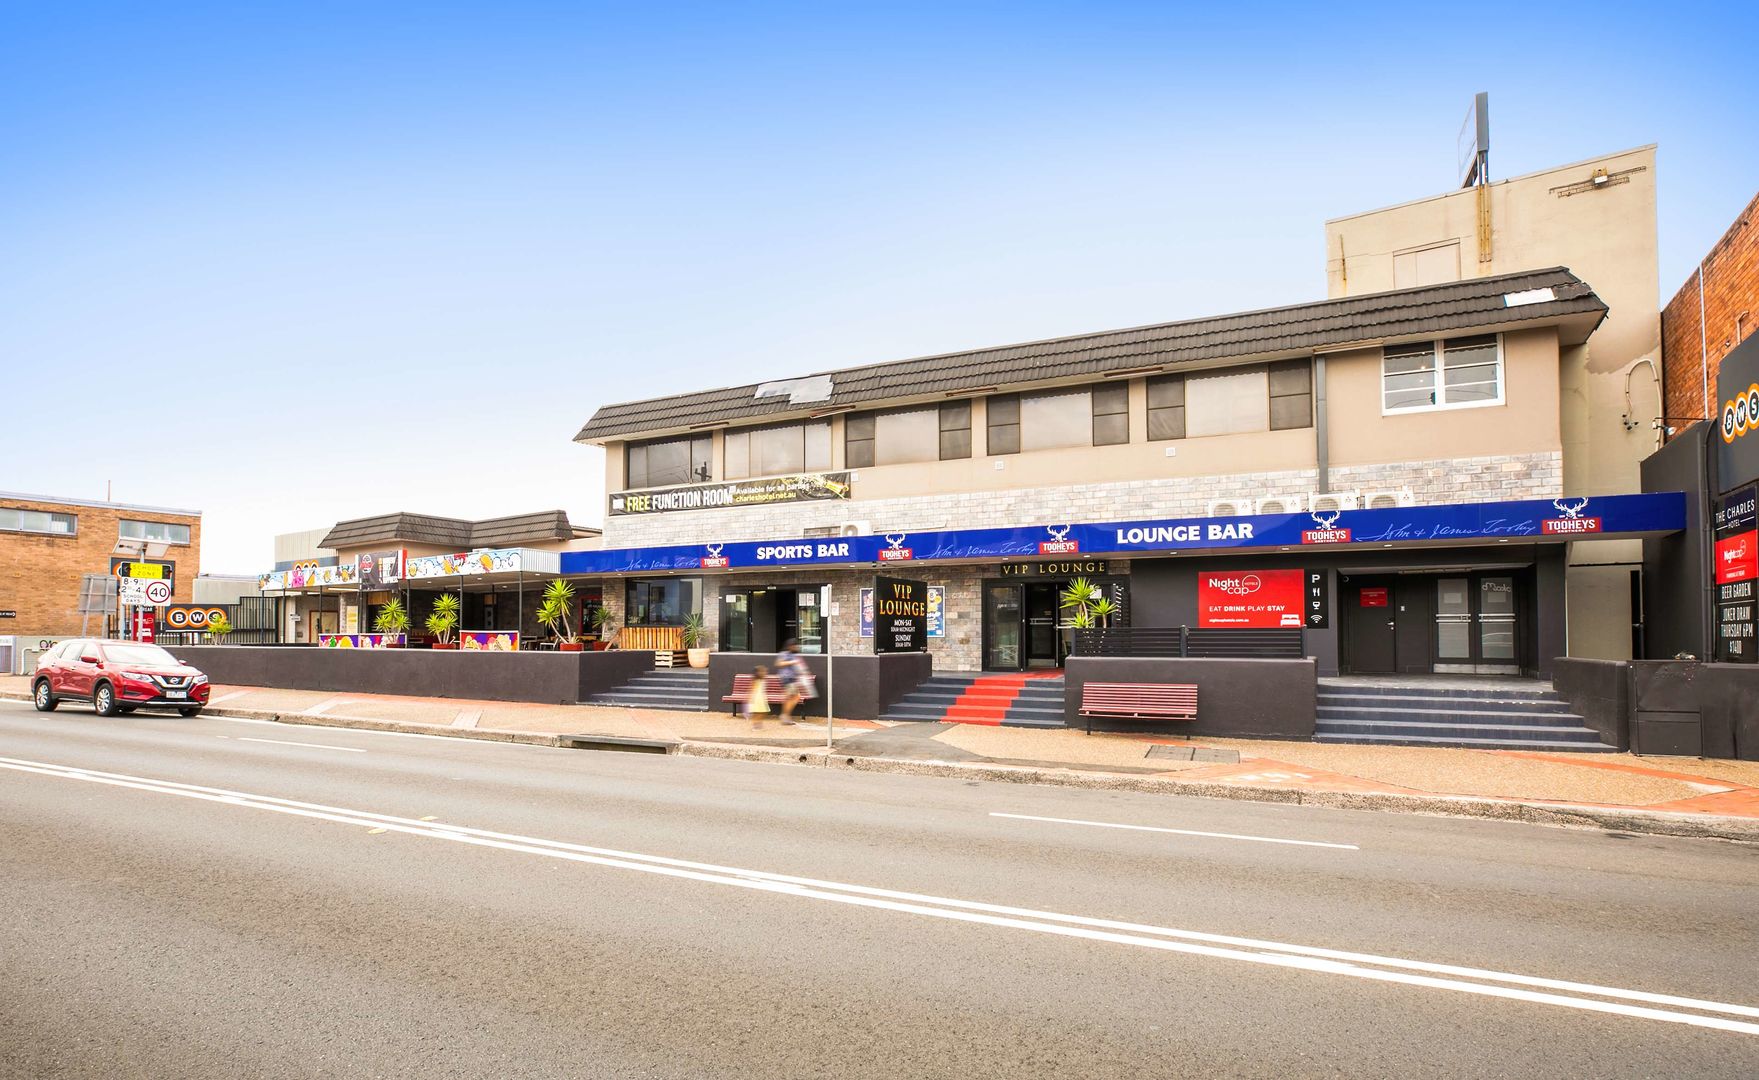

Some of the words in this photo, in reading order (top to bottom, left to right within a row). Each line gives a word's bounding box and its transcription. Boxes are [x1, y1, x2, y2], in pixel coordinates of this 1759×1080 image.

[1726, 398, 1757, 430] BWS
[736, 485, 765, 494] Available
[626, 496, 650, 511] FREE
[652, 490, 700, 510] FUNCTION
[703, 488, 733, 506] ROOM
[1715, 510, 1725, 523] THE
[1726, 499, 1755, 519] CHARLES
[1547, 519, 1595, 530] TOOHEYS
[1728, 519, 1740, 529] HOTEL
[1117, 525, 1200, 544] LOUNGE
[1208, 523, 1254, 540] BAR
[1306, 530, 1346, 540] TOOHEYS
[756, 545, 813, 560] SPORTS
[817, 543, 849, 557] BAR
[1042, 542, 1075, 551] TOOHEYS
[882, 549, 909, 558] TOOHEYS
[704, 558, 726, 566] TOOHEYS
[1003, 564, 1029, 574] VIP
[1040, 562, 1105, 574] LOUNGE
[150, 587, 167, 597] 40
[893, 584, 912, 600] VIP
[1722, 584, 1732, 599] BEER
[1733, 582, 1751, 598] GARDEN
[880, 599, 925, 617] LOUNGE
[1723, 607, 1736, 621] JOKER
[1736, 606, 1751, 621] DRAW
[1720, 623, 1742, 637] THURSDAY
[1742, 623, 1753, 637] 6PM
[895, 634, 912, 642] SUNDAY
